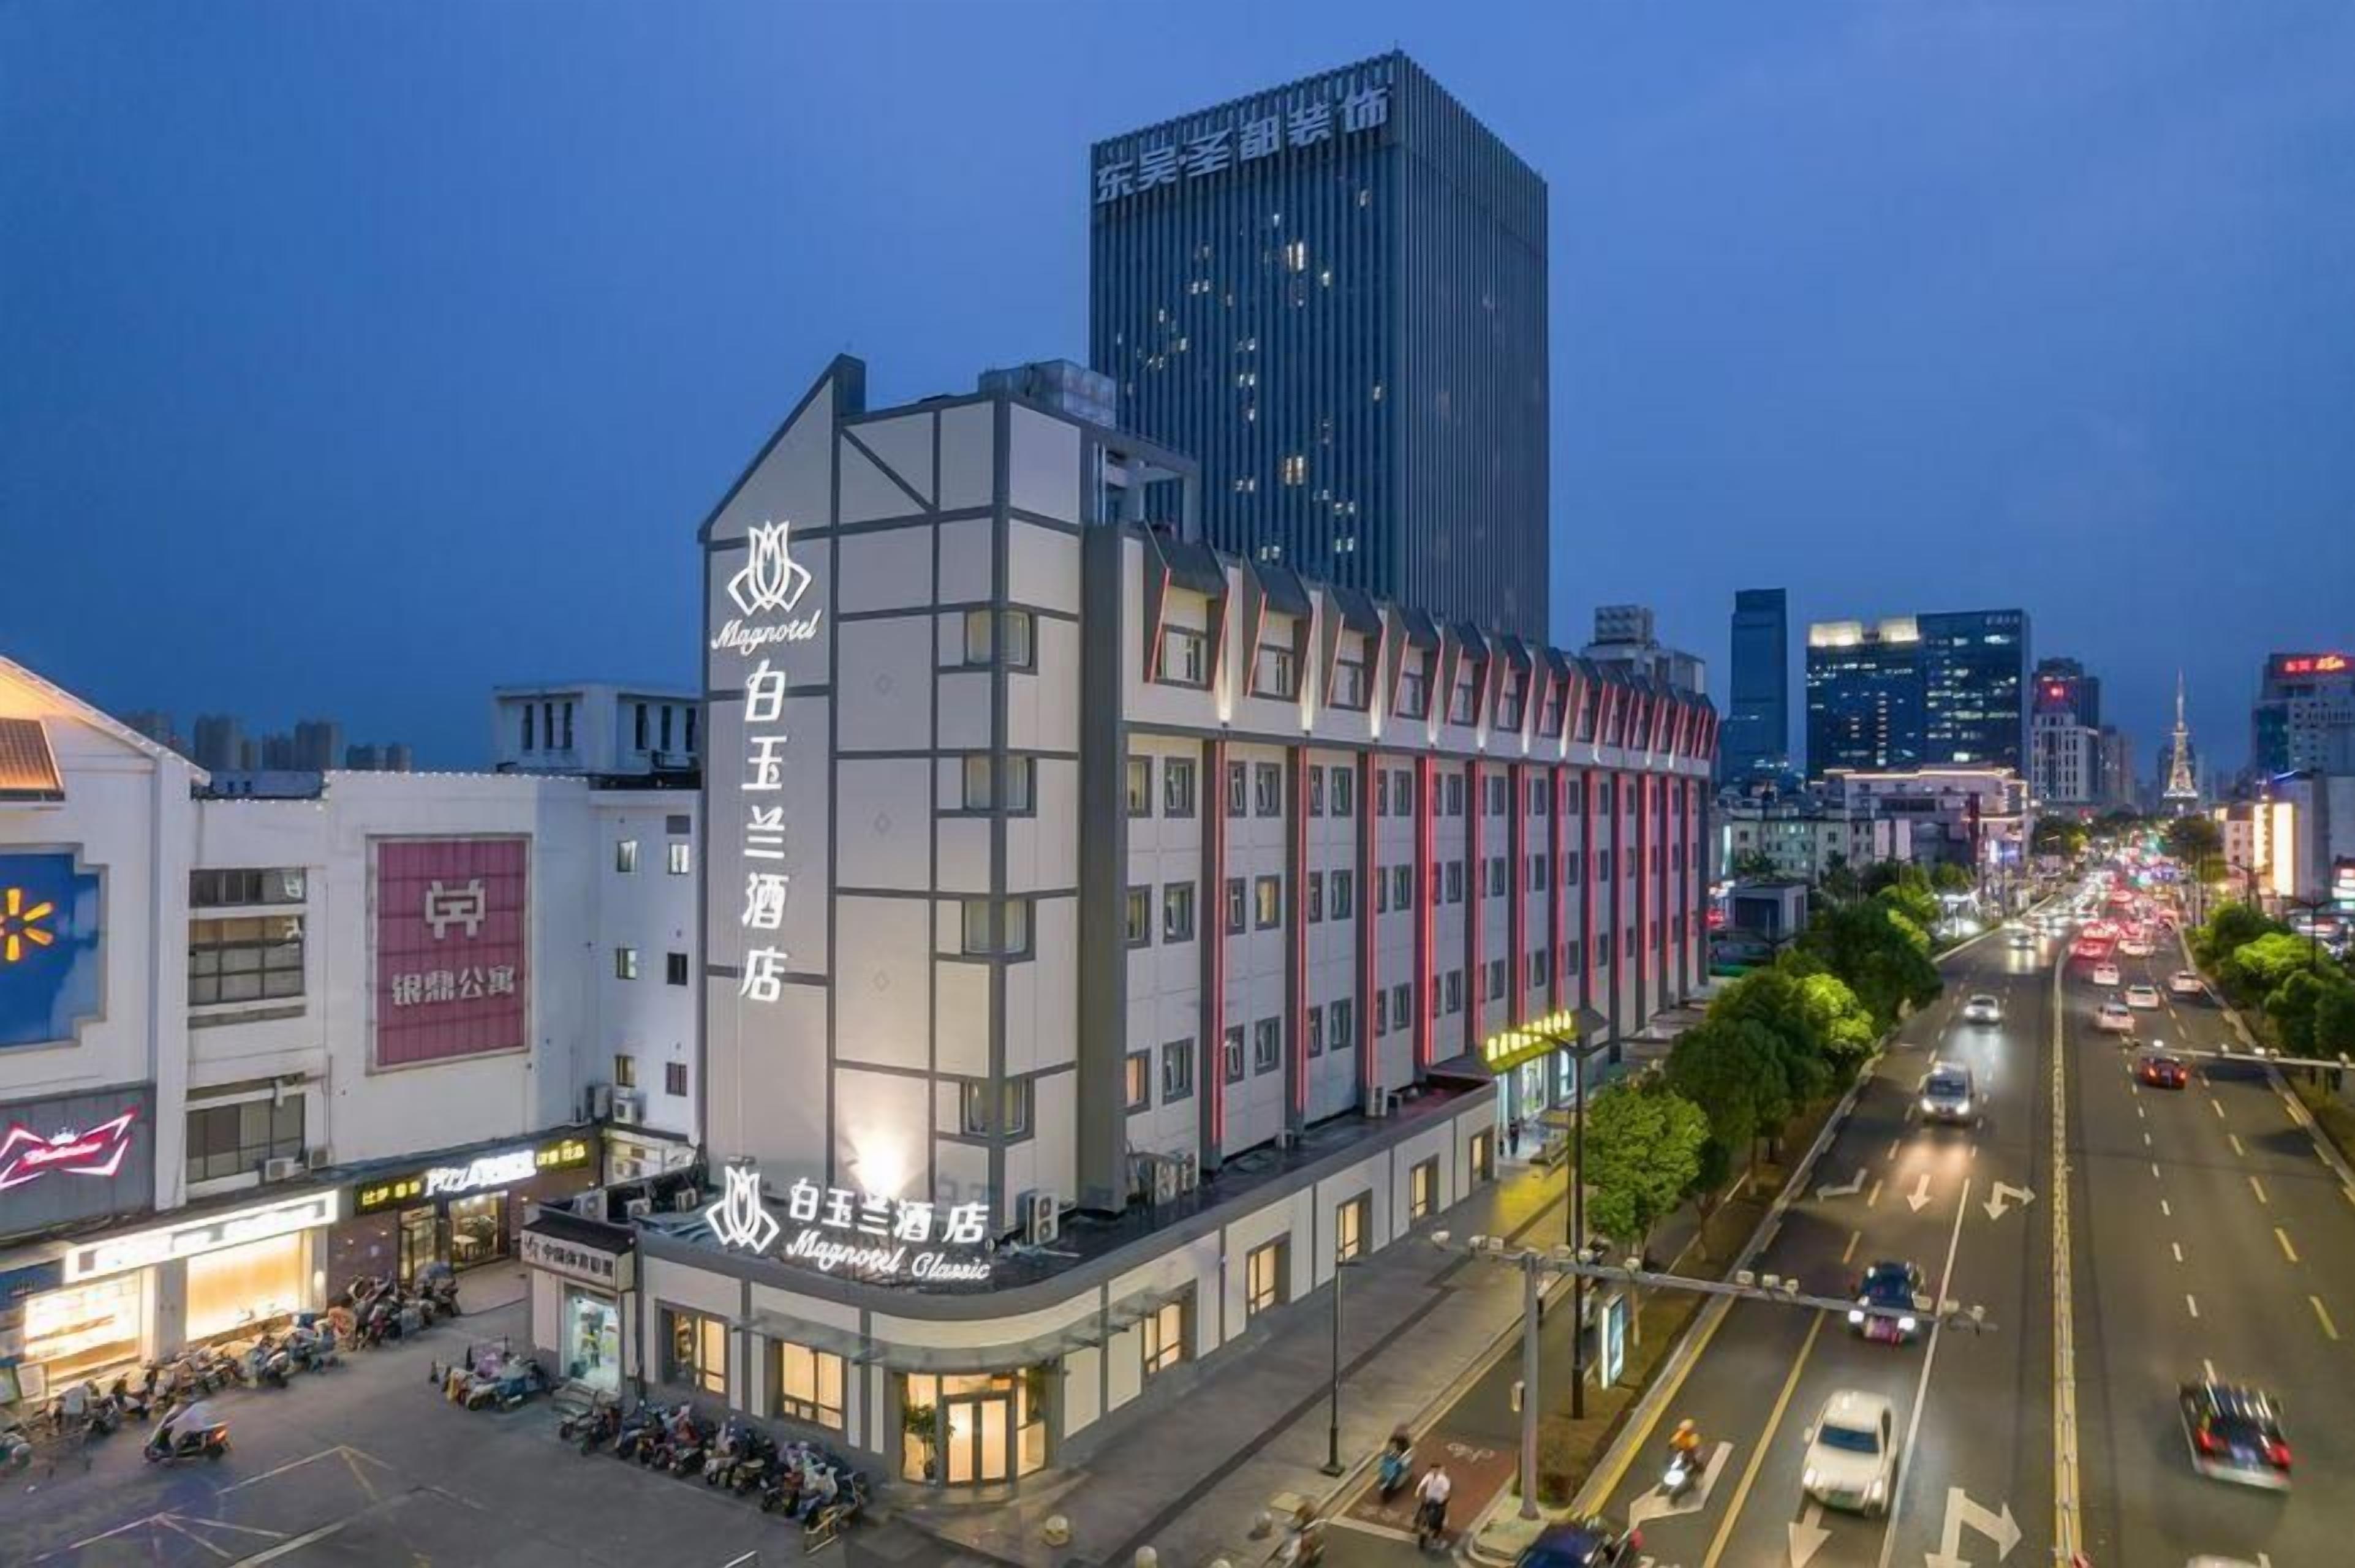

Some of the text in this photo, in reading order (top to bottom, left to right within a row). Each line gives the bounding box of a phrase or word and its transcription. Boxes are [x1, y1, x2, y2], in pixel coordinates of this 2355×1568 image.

[711, 610, 821, 656] Magnotel
[739, 658, 789, 1002] 白玉兰酒店
[790, 1177, 989, 1243] 白玉兰酒店
[786, 1229, 991, 1280] Magnotel Classic
